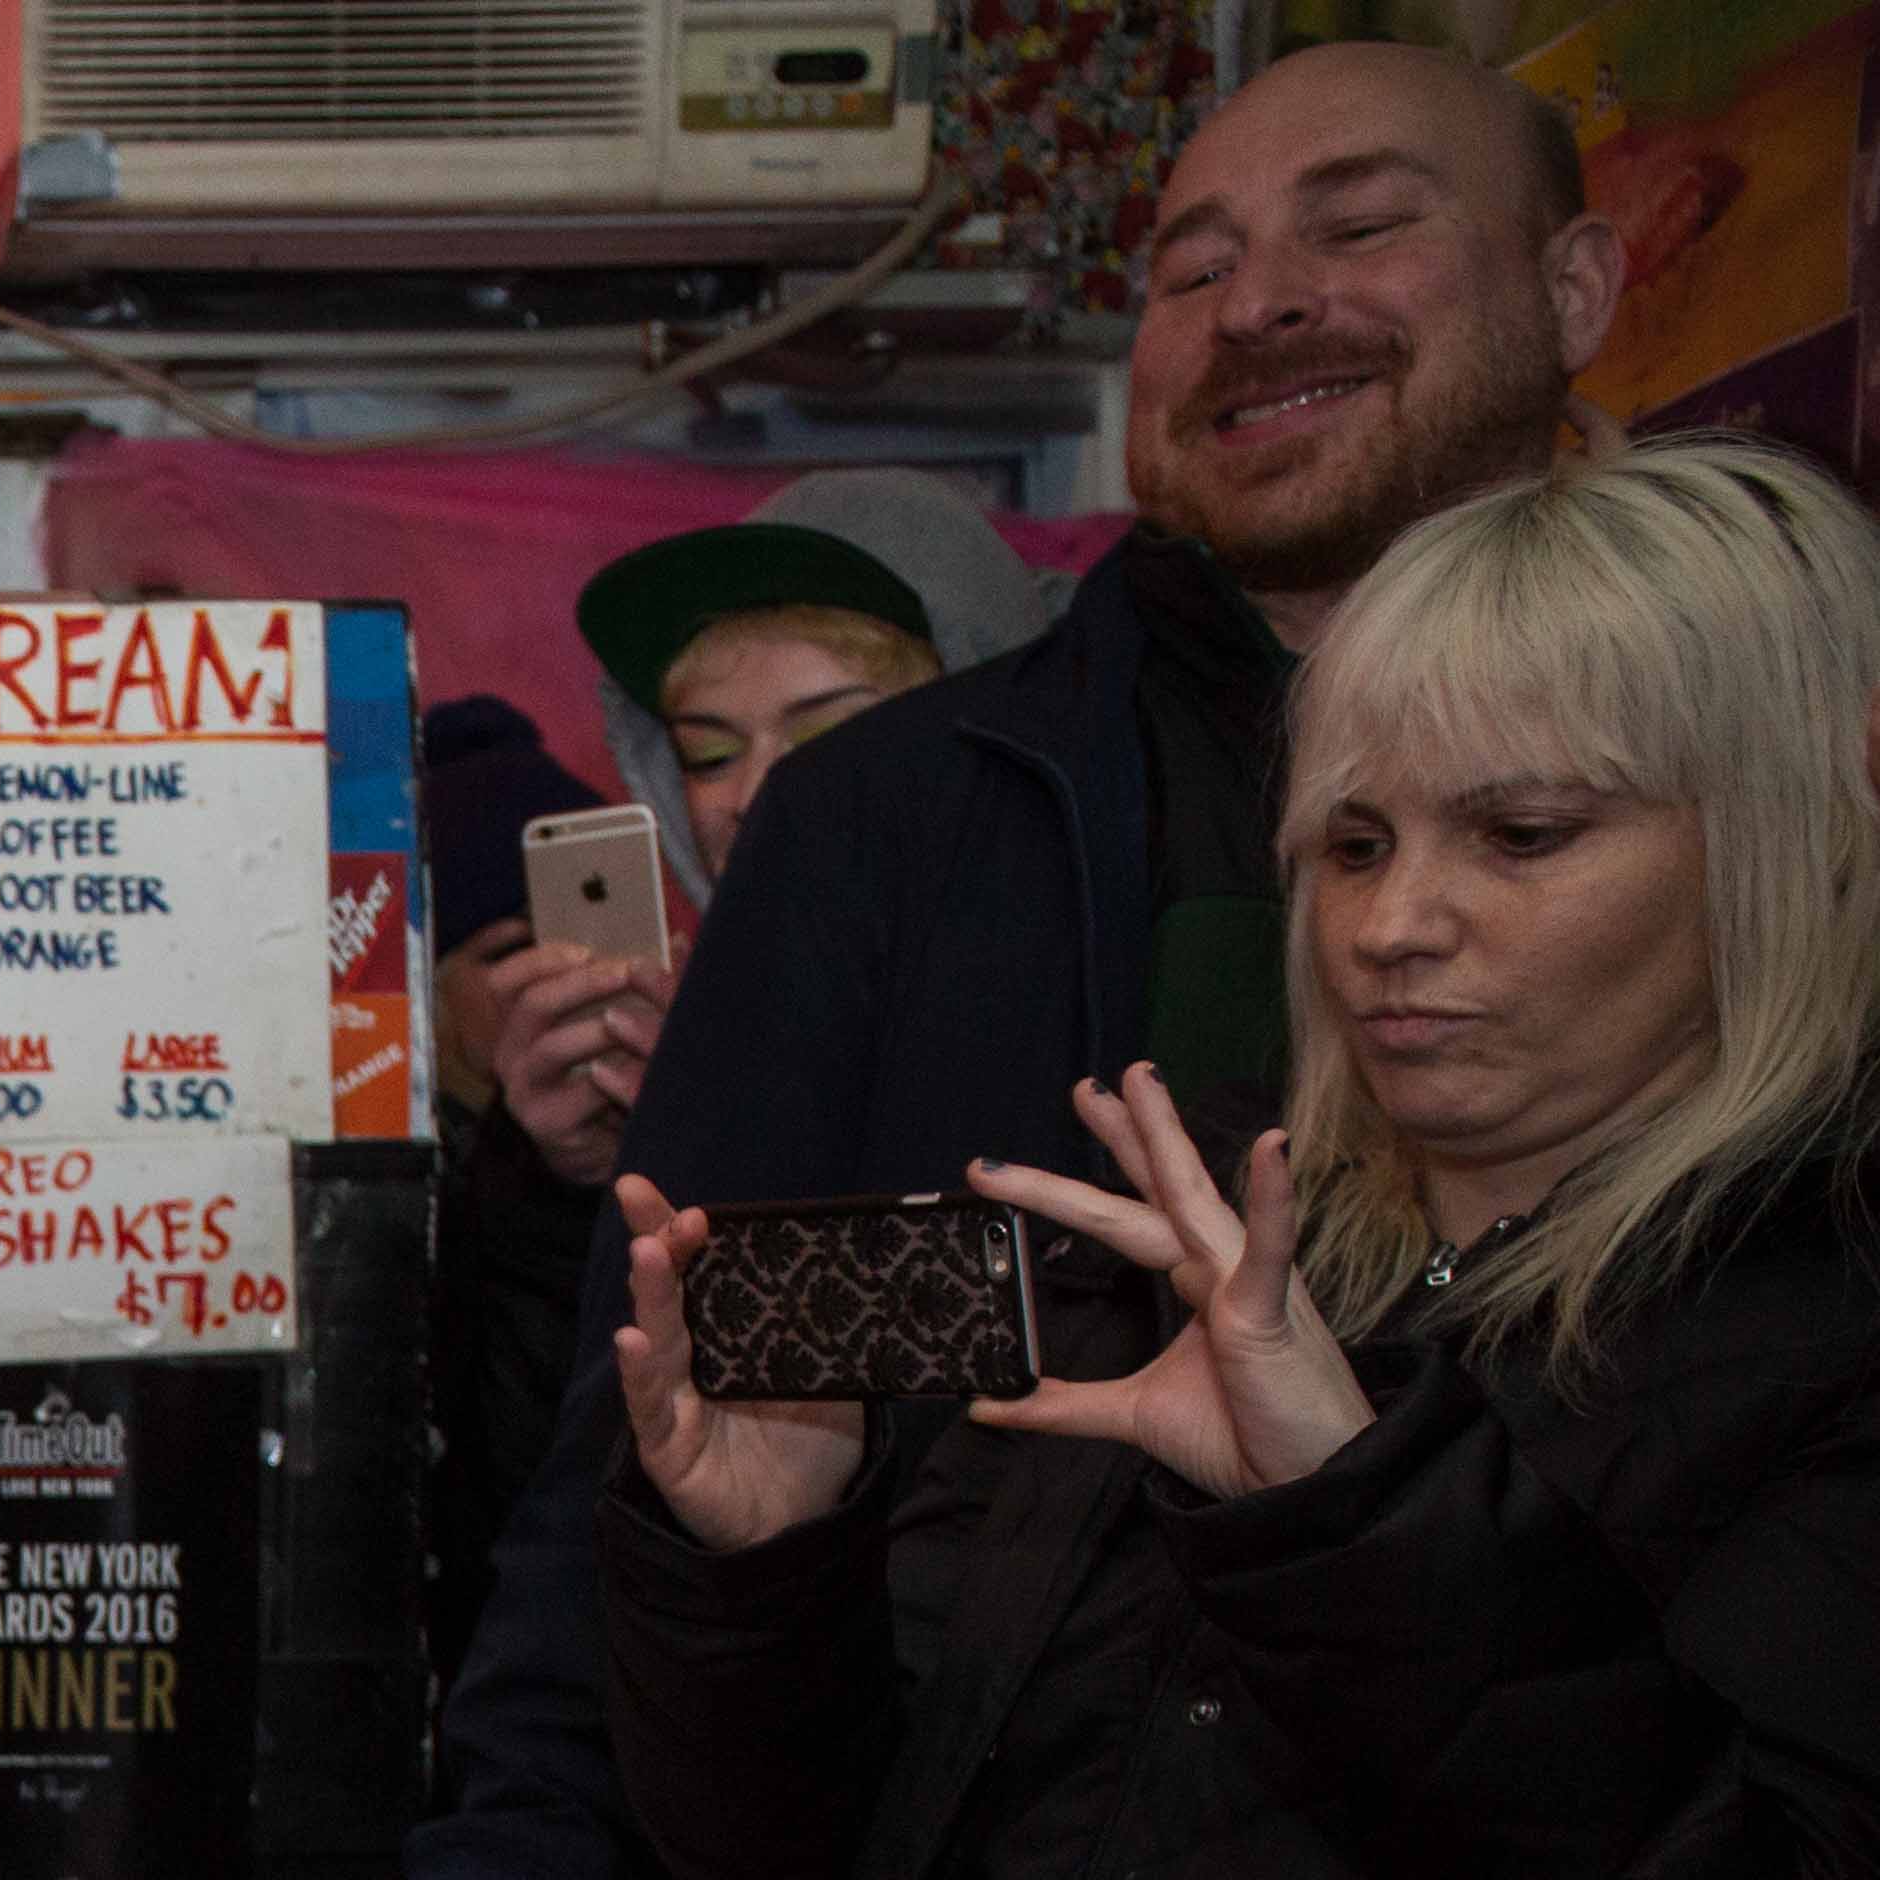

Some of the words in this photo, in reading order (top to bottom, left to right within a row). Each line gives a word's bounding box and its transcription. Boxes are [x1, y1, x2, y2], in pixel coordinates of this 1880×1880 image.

[72, 872, 172, 916] BEER
[119, 1032, 226, 1070] LARGE
[334, 1042, 404, 1096] RANGE
[116, 1270, 288, 1337] $7.00
[20, 1541, 92, 1589] NEW
[96, 1541, 182, 1589] YORK
[83, 1592, 179, 1643] 2016
